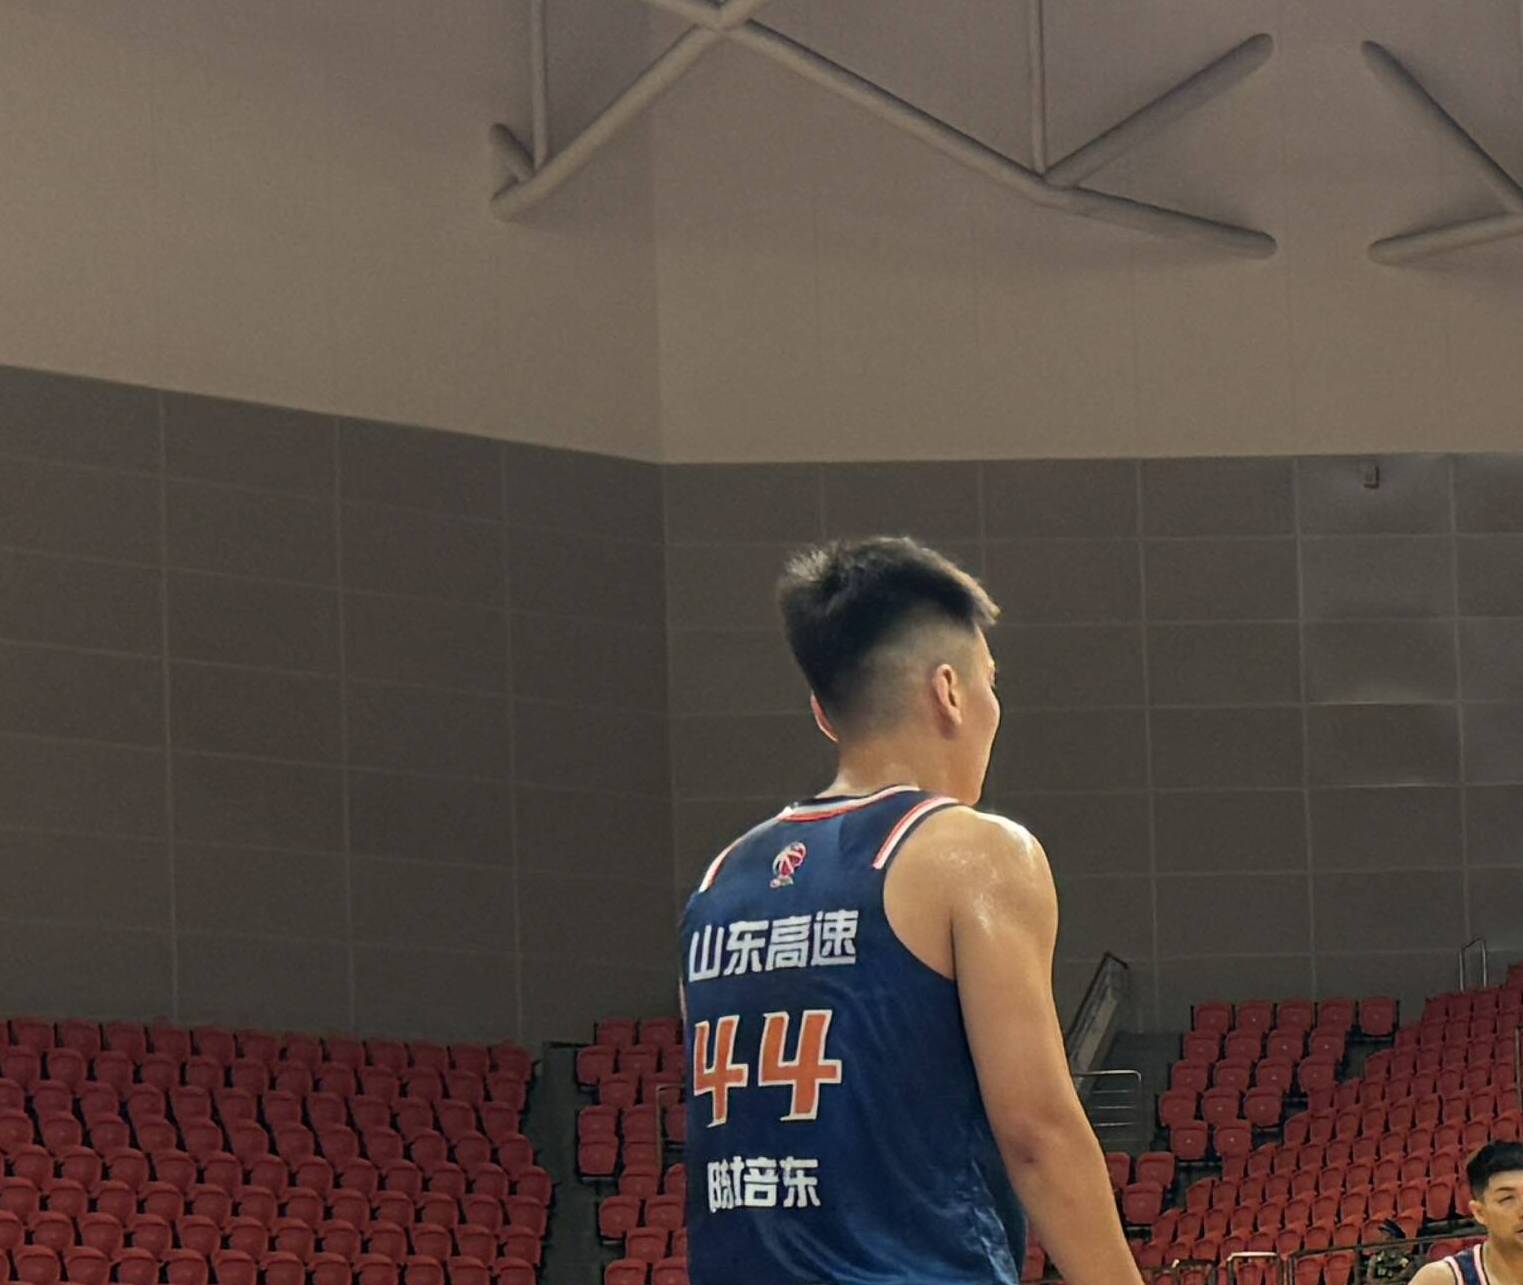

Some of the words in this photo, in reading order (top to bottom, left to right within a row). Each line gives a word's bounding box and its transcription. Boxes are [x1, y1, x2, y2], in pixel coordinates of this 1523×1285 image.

[687, 909, 860, 983] 山东高速
[693, 1008, 844, 1129] 44
